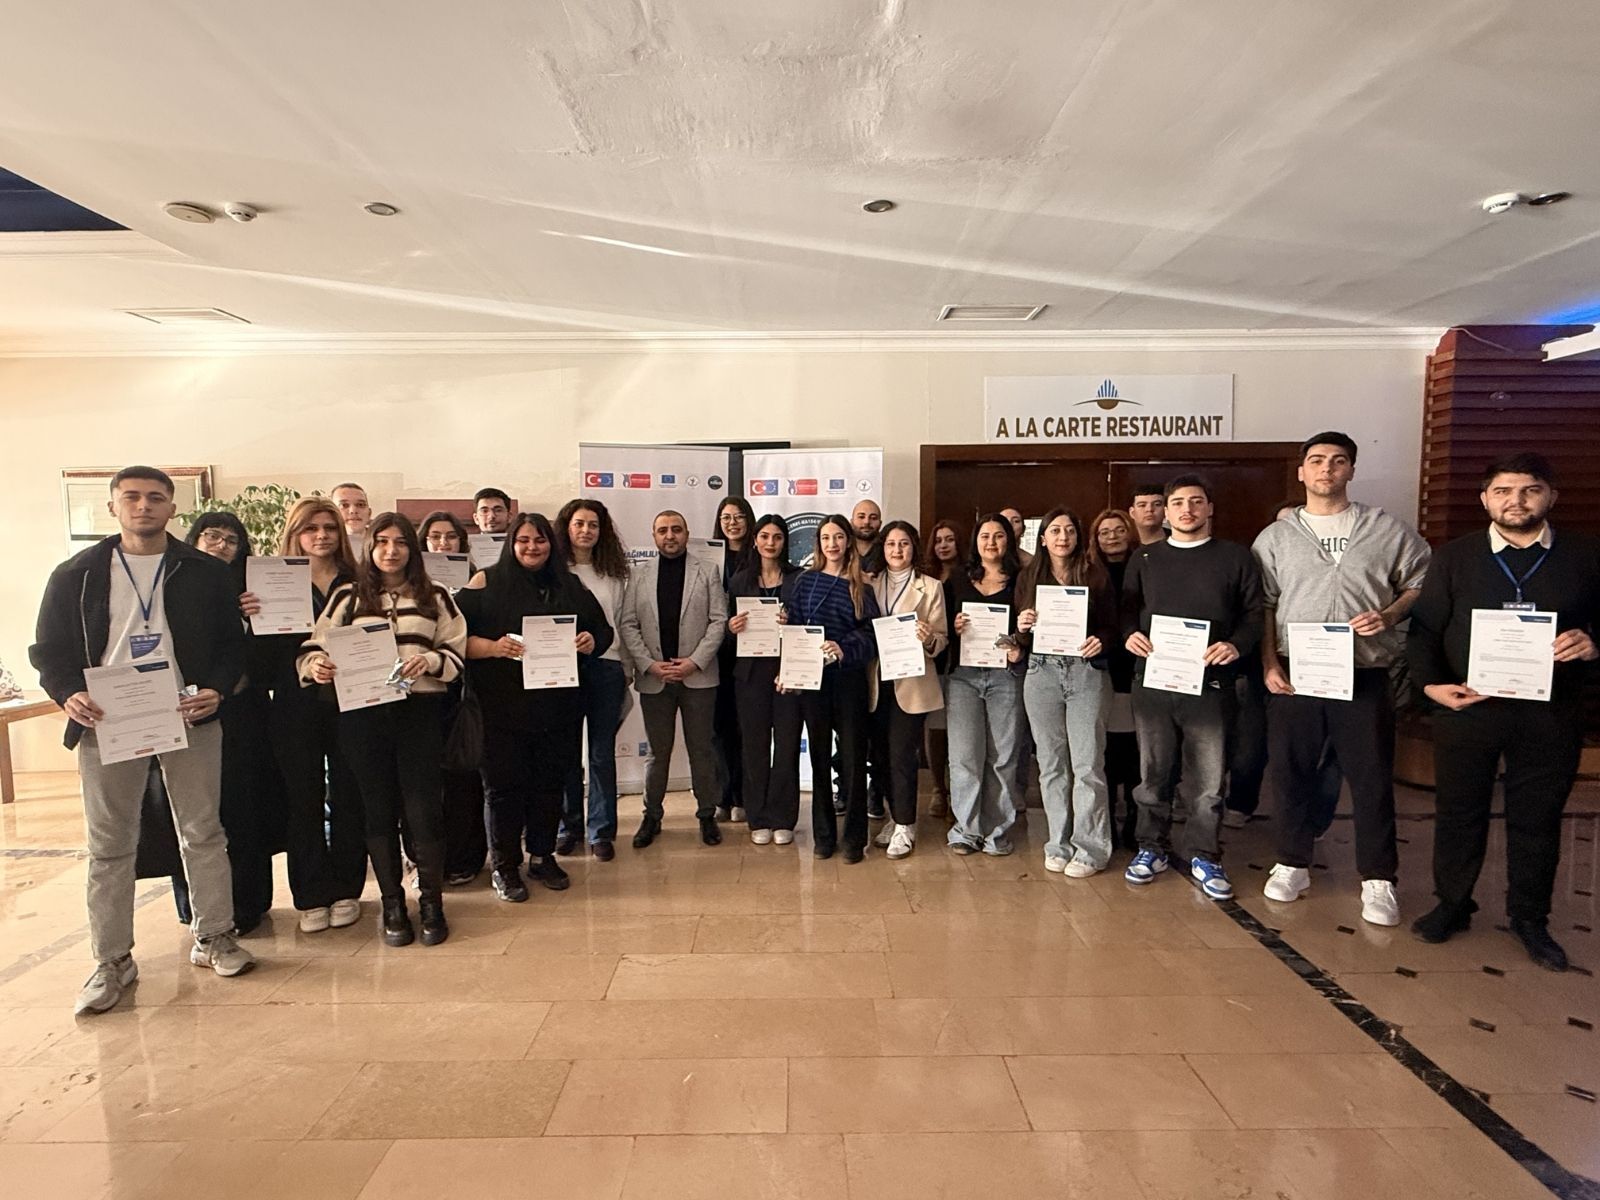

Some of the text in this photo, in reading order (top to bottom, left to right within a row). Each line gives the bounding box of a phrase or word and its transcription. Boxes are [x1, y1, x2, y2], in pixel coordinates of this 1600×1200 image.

[996, 415, 1224, 438] A LA CARTE RESTAURANT
[1321, 537, 1349, 552] HIG
[623, 549, 658, 558] AĞIMLILI
